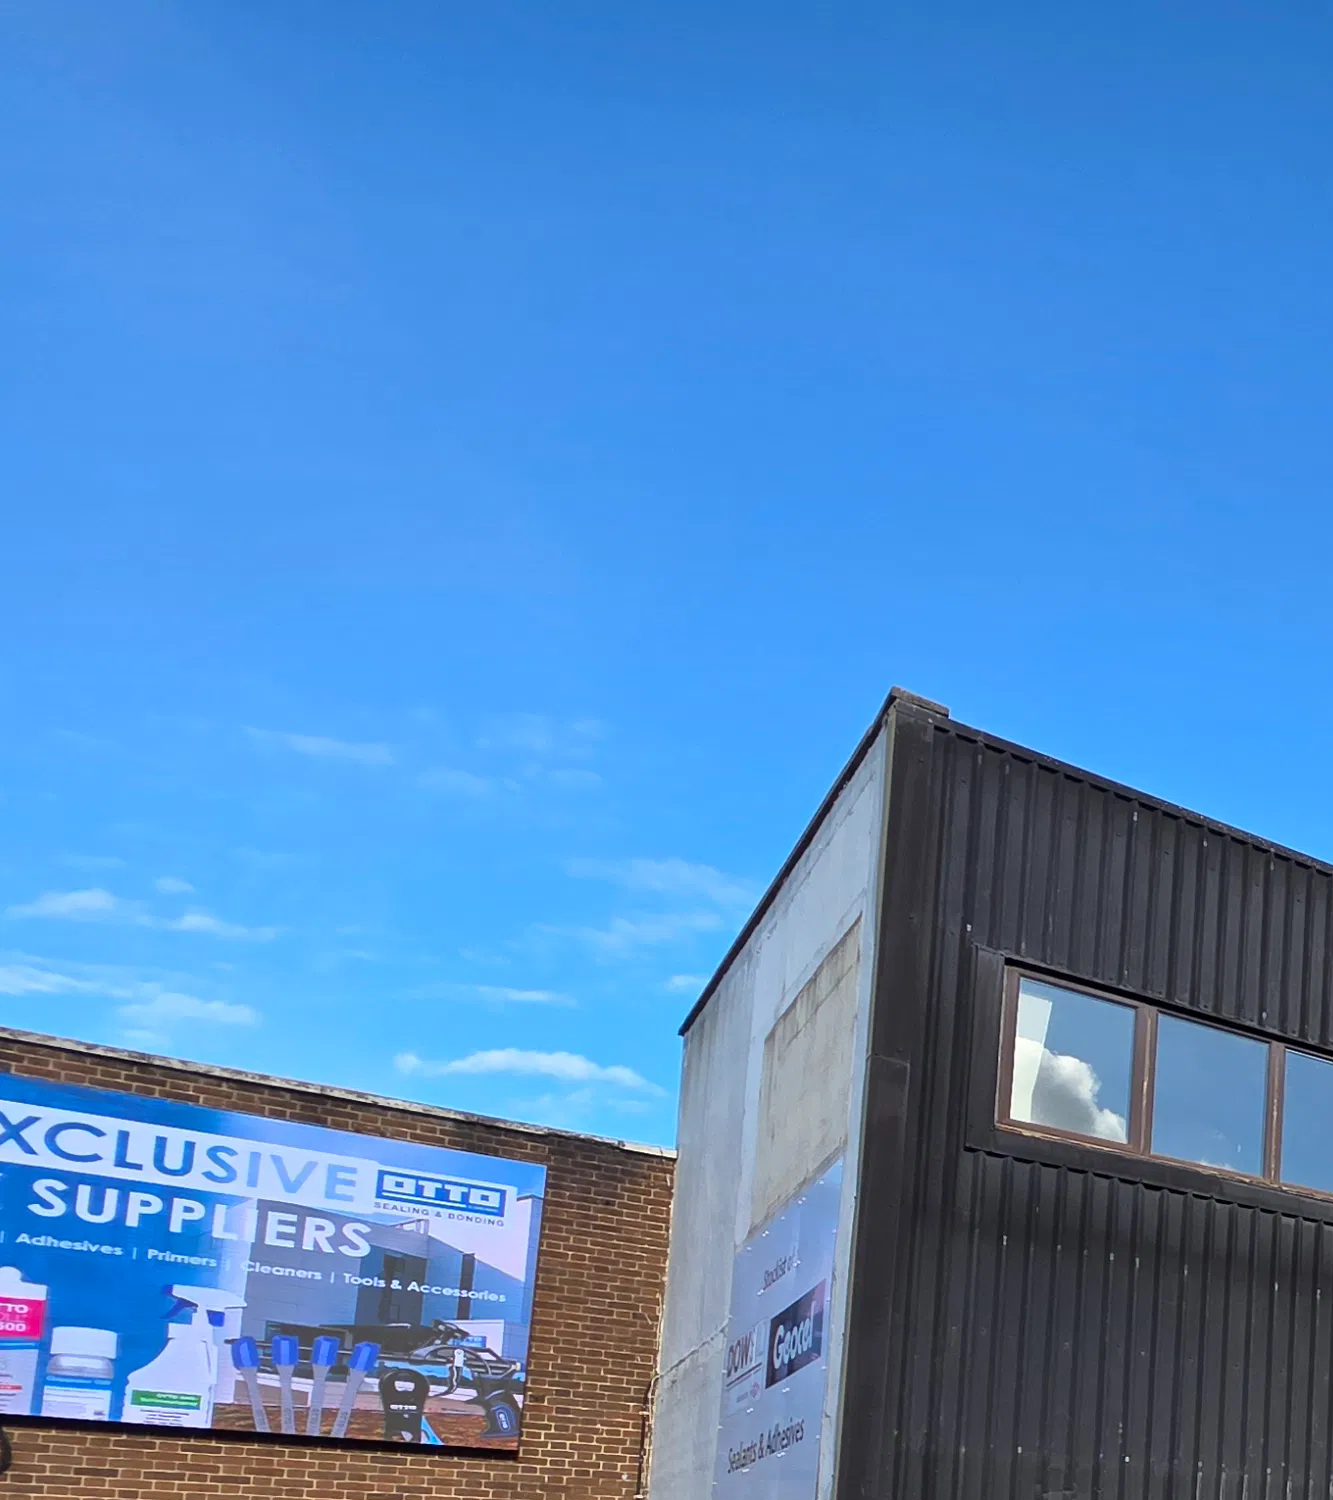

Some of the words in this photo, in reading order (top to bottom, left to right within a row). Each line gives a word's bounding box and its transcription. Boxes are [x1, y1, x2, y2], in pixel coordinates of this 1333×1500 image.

[27, 1179, 372, 1258] SUPPLIERS
[374, 1202, 430, 1216] SEALING
[448, 1213, 505, 1227] BONDING
[382, 1174, 501, 1208] OTTO
[16, 1233, 123, 1256] Adhesives
[147, 1249, 217, 1267] Primers
[240, 1260, 322, 1280] Cleaners
[344, 1273, 386, 1287] Tools
[390, 1279, 402, 1290] &
[407, 1281, 506, 1302] Accessories
[773, 1300, 816, 1369] Geocel
[728, 1441, 757, 1474] Sealants
[765, 1416, 805, 1457] Adhesives
